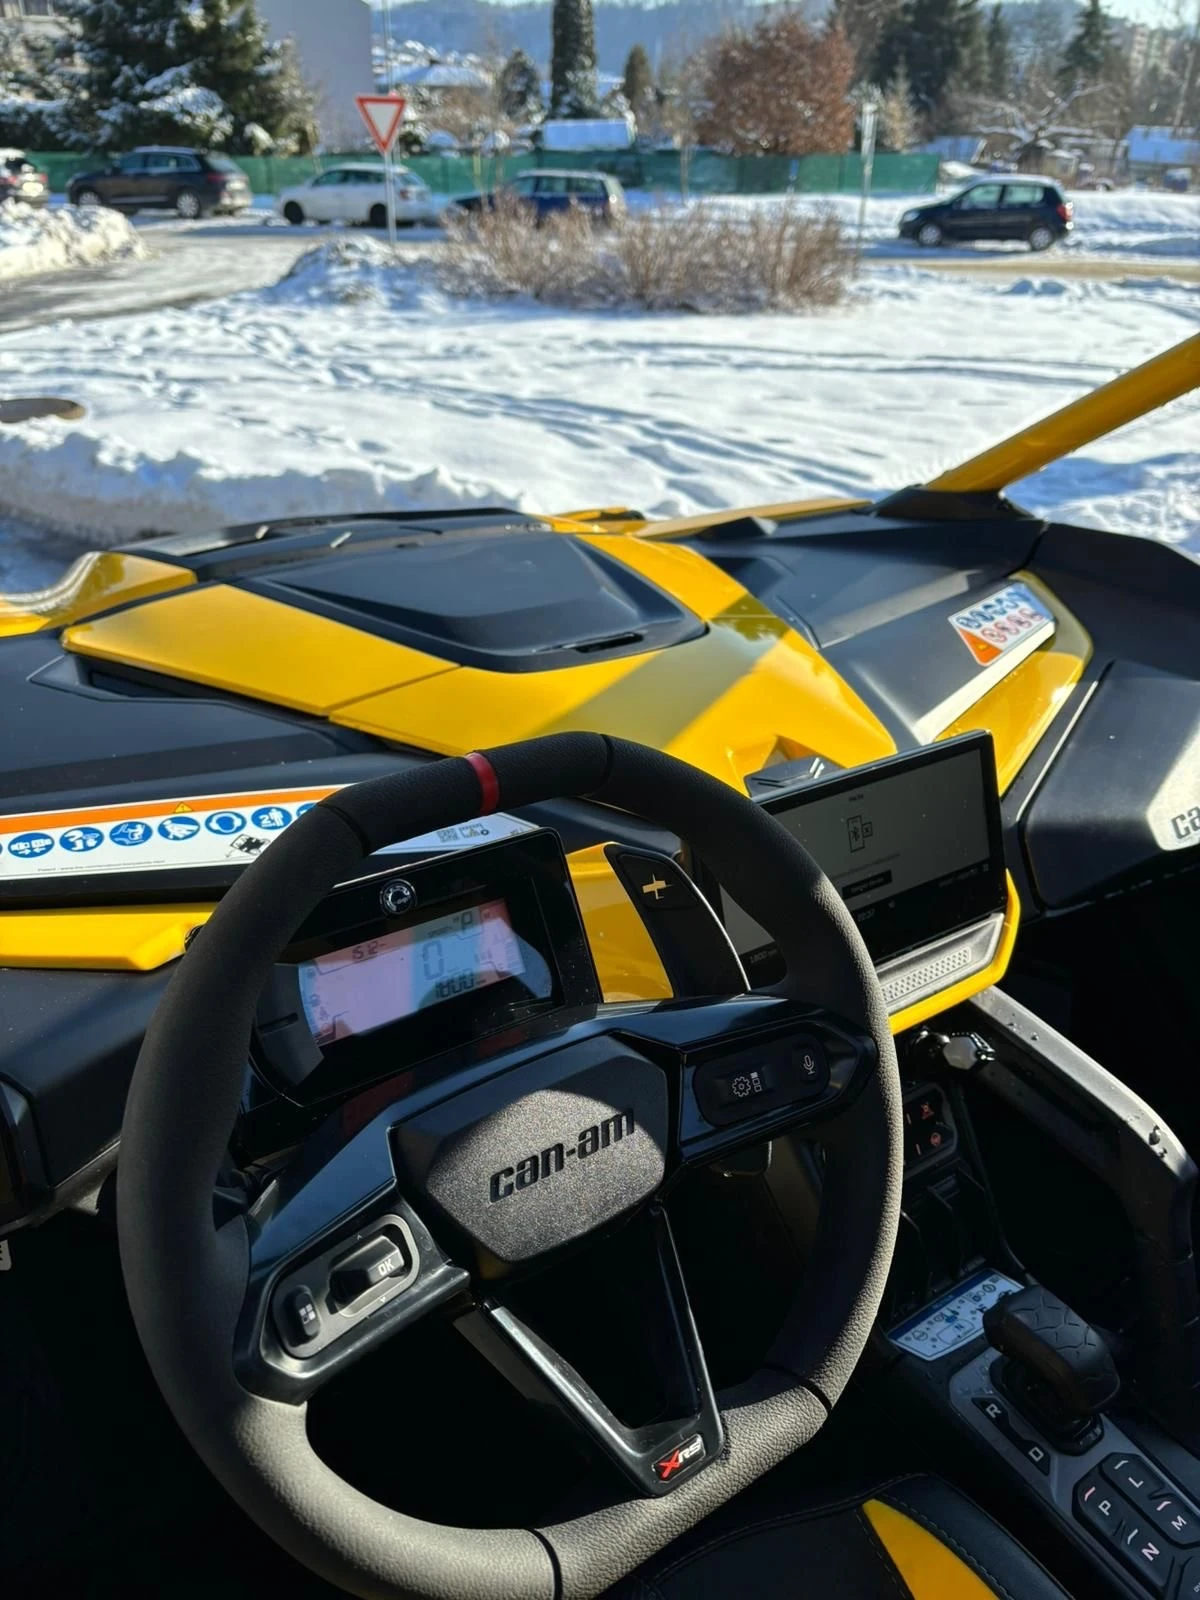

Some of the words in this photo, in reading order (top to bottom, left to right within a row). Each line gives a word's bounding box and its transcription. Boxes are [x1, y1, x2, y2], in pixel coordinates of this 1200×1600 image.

[489, 1108, 634, 1203] can-am
[378, 1258, 395, 1276] OK
[985, 1403, 1001, 1418] R
[1028, 1446, 1044, 1462] D
[1128, 1477, 1144, 1488] L
[1098, 1500, 1111, 1516] P
[1171, 1515, 1187, 1531] M
[1141, 1542, 1160, 1561] N
